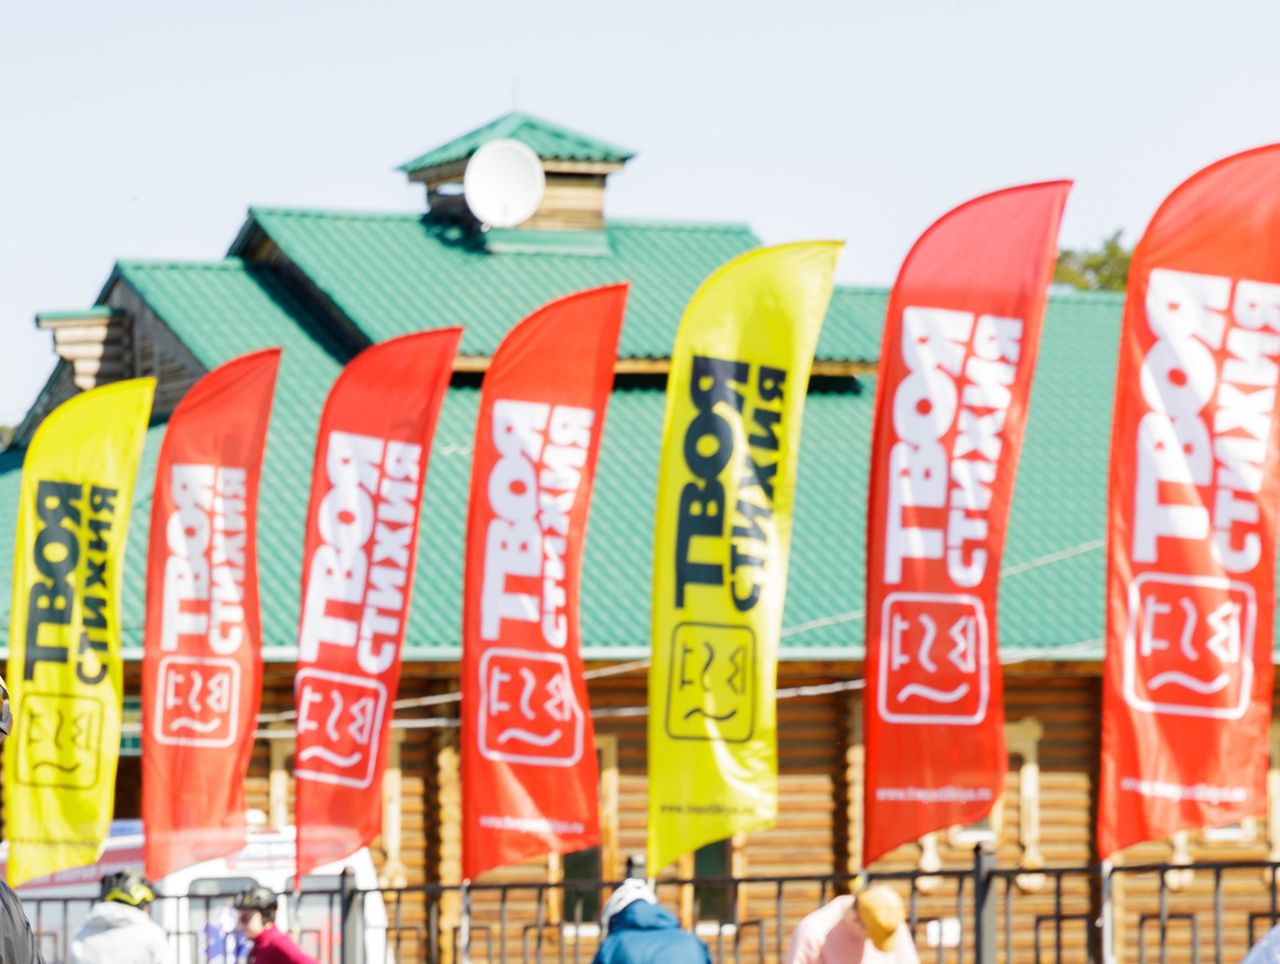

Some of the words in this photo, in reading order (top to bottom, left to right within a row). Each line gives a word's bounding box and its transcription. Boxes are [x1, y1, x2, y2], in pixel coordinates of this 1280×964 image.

[480, 399, 551, 641] ТВОЯ
[539, 404, 595, 648] СТИХИЯ
[675, 355, 750, 609] ТВОЯ
[730, 365, 787, 612] СТИХИЯ
[883, 305, 975, 584] ТВОЯ
[946, 313, 1023, 588] СТИХИЯ
[1132, 267, 1232, 563] ТВОЯ
[1210, 278, 1280, 573] СТИХИЯ
[23, 479, 83, 682] ТВОЯ
[76, 485, 119, 685] СТИХИЯ
[160, 464, 215, 652] ТВОЯ
[208, 466, 247, 655] СТИХИЯ
[299, 430, 385, 663] ТВОЯ
[357, 439, 422, 674] СТИХИЯ
